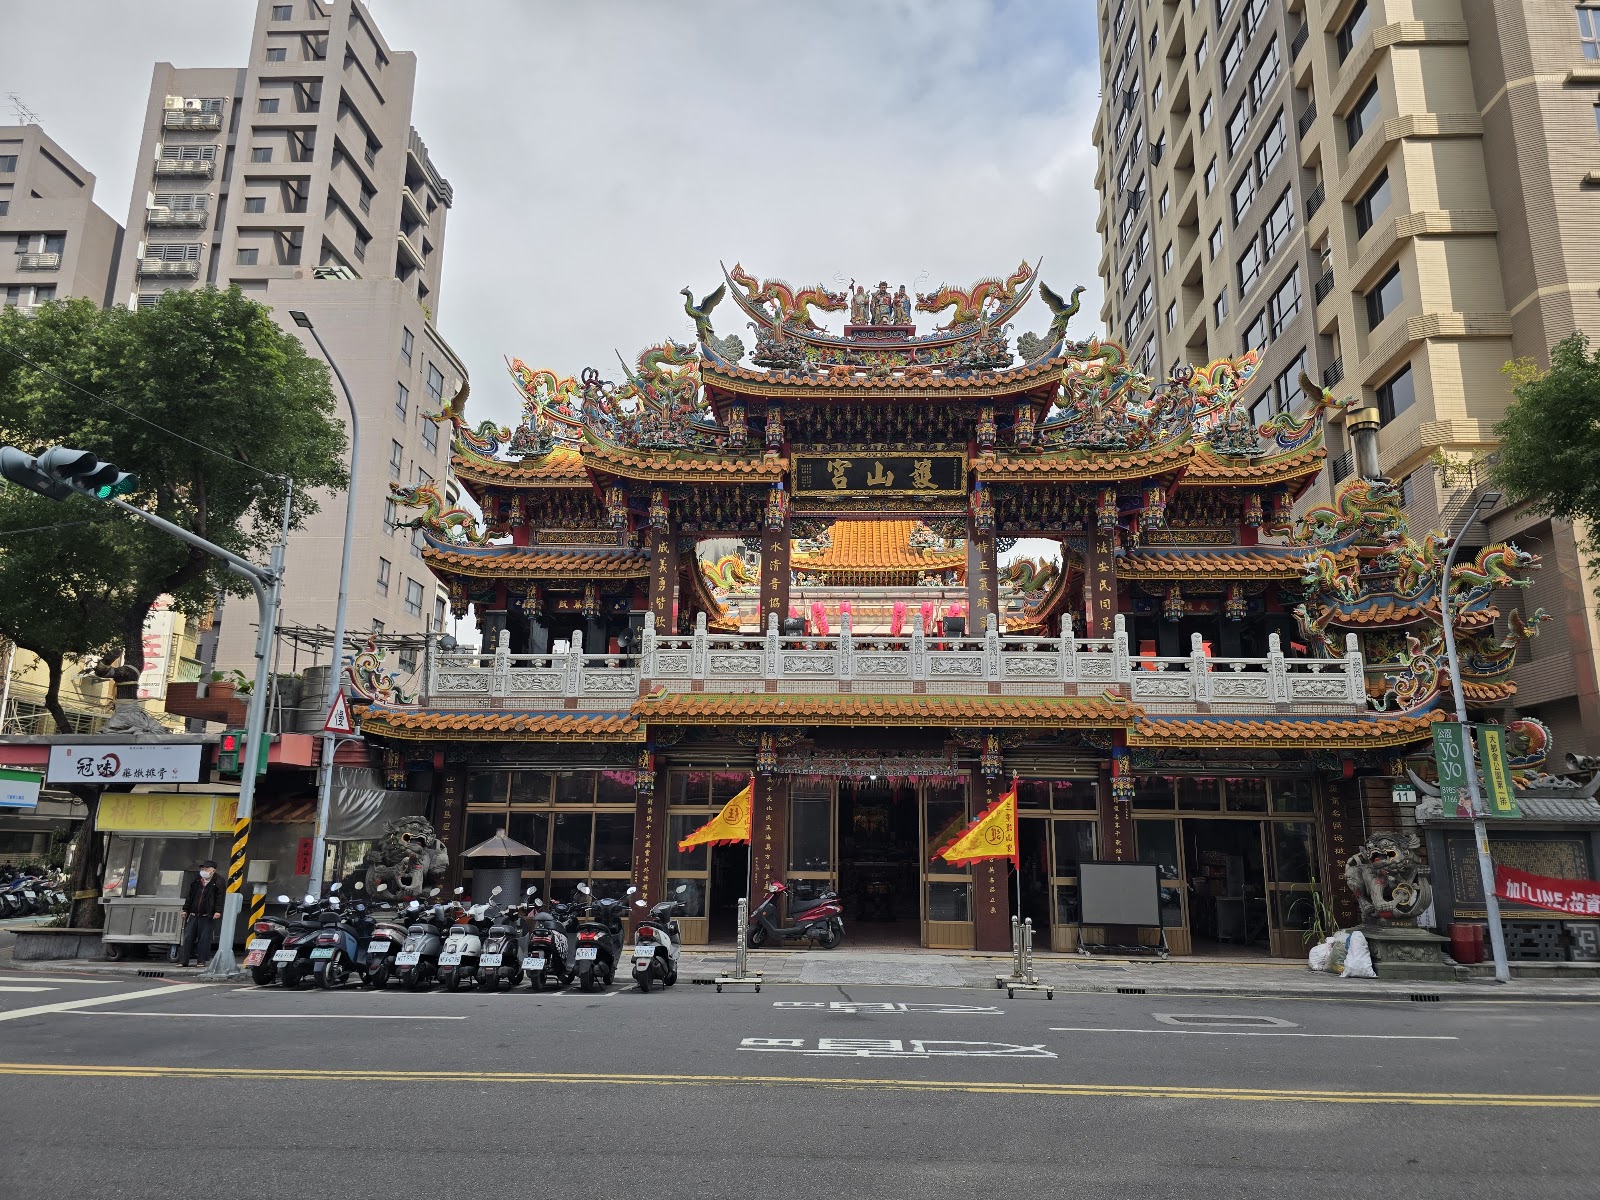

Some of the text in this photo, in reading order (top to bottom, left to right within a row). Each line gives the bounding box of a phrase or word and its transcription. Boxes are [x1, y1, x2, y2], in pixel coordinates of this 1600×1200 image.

[335, 710, 344, 727] 慢
[77, 757, 115, 778] 冠味
[1397, 792, 1408, 801] 11
